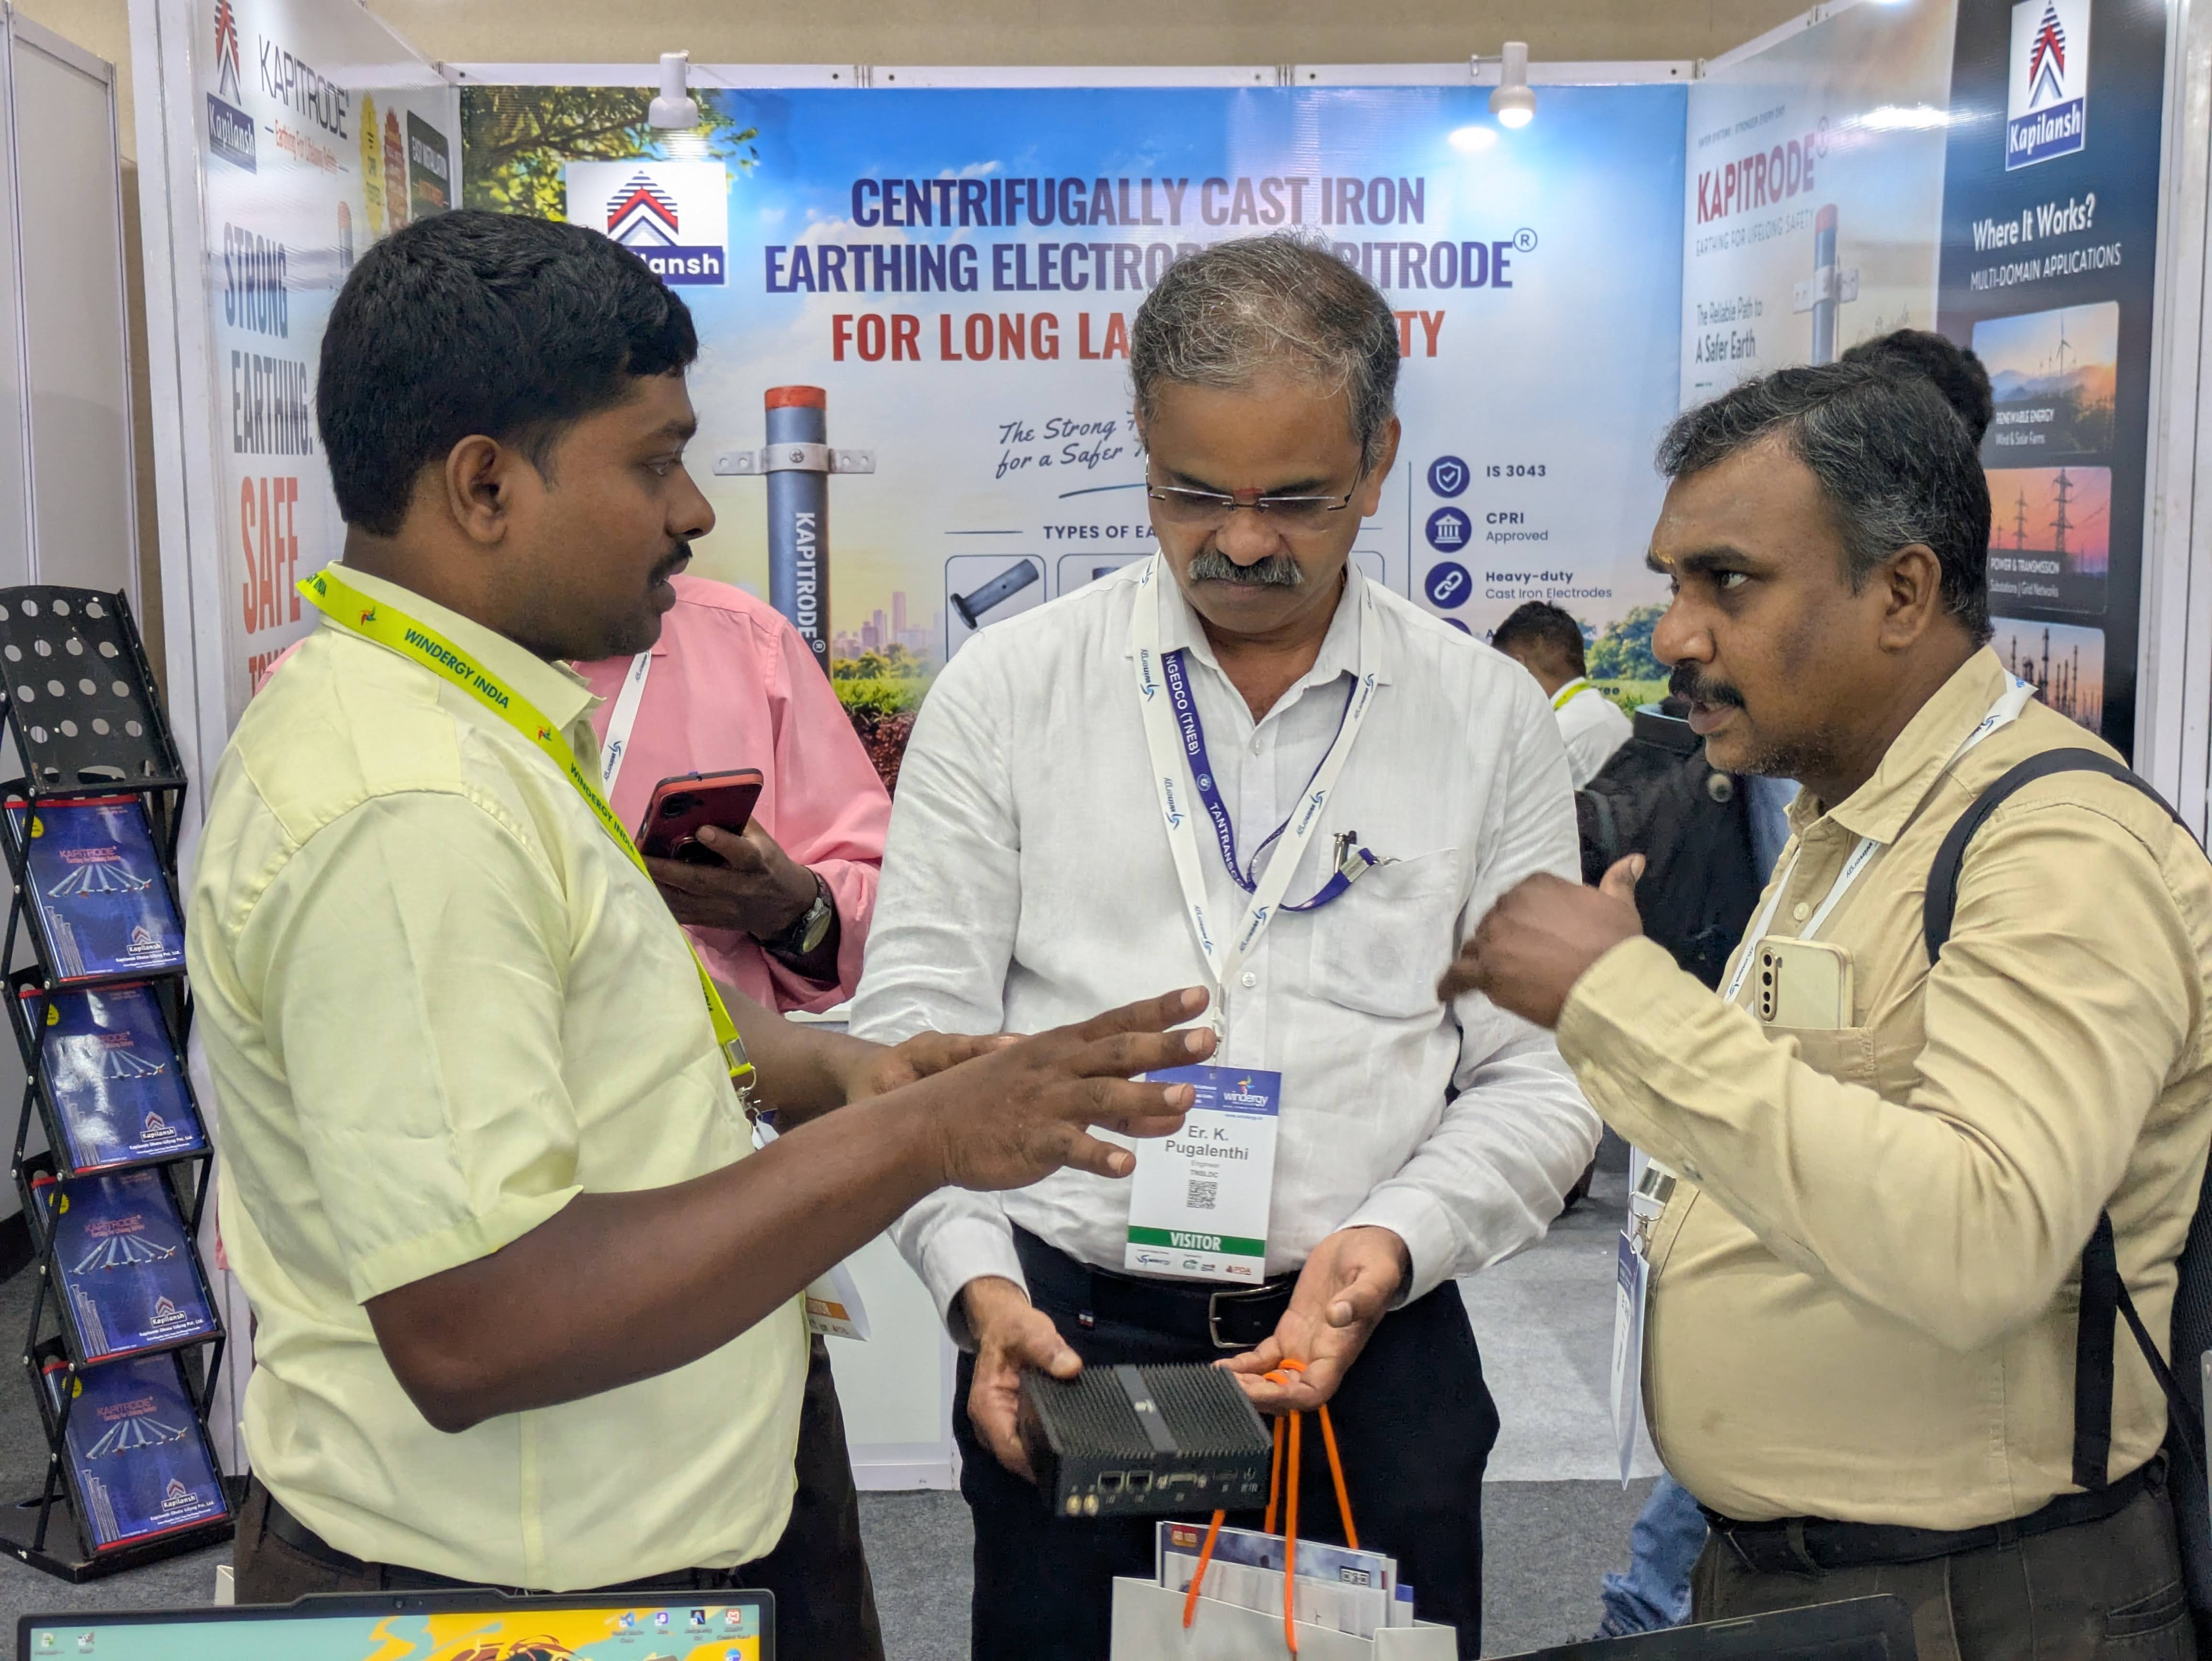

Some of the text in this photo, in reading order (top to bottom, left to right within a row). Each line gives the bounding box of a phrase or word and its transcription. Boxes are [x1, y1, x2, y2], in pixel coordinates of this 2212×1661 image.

[259, 34, 347, 140] KAPITRODE
[208, 102, 255, 157] Kapilansh
[2010, 103, 2081, 155] Kapilansh
[852, 177, 1425, 227] CENTRIFUGALLY CAST IRON
[1972, 192, 2096, 252] Where It Works?
[224, 221, 288, 336] STRONG
[765, 244, 978, 293] EARTHING
[993, 242, 1214, 291] ELECTRO
[1970, 242, 2122, 291] MULTI-DOMAIN APPLICATIONS
[832, 313, 921, 362] FOR
[940, 312, 1060, 361] LONG
[1705, 332, 1728, 363] Safer
[1731, 328, 1756, 360] Earth
[232, 350, 313, 456] EARTHING.
[999, 421, 1035, 444] The
[1043, 418, 1117, 441] Strong
[995, 449, 1032, 479] for
[1039, 455, 1052, 467] a
[1060, 441, 1123, 469] Safer
[1486, 465, 1547, 477] IS 3043
[1043, 525, 1099, 540] TYPES
[1106, 525, 1129, 538] OF
[1486, 512, 1525, 524] CPRI
[1486, 530, 1548, 544] Approved
[241, 476, 301, 634] SAFE
[1486, 571, 1573, 585] Heavy-duty
[1485, 587, 1613, 598] Cast Iron Electrodes
[404, 628, 509, 709] WINDERGY INDIA
[1165, 654, 1201, 755] NGEDCO (TNEB)
[571, 762, 635, 853] WINDERGY INDIA
[1165, 1140, 1249, 1160] Pugalenthi
[1188, 1126, 1229, 1141] Er. K.
[1170, 1231, 1221, 1251] VISITOR
